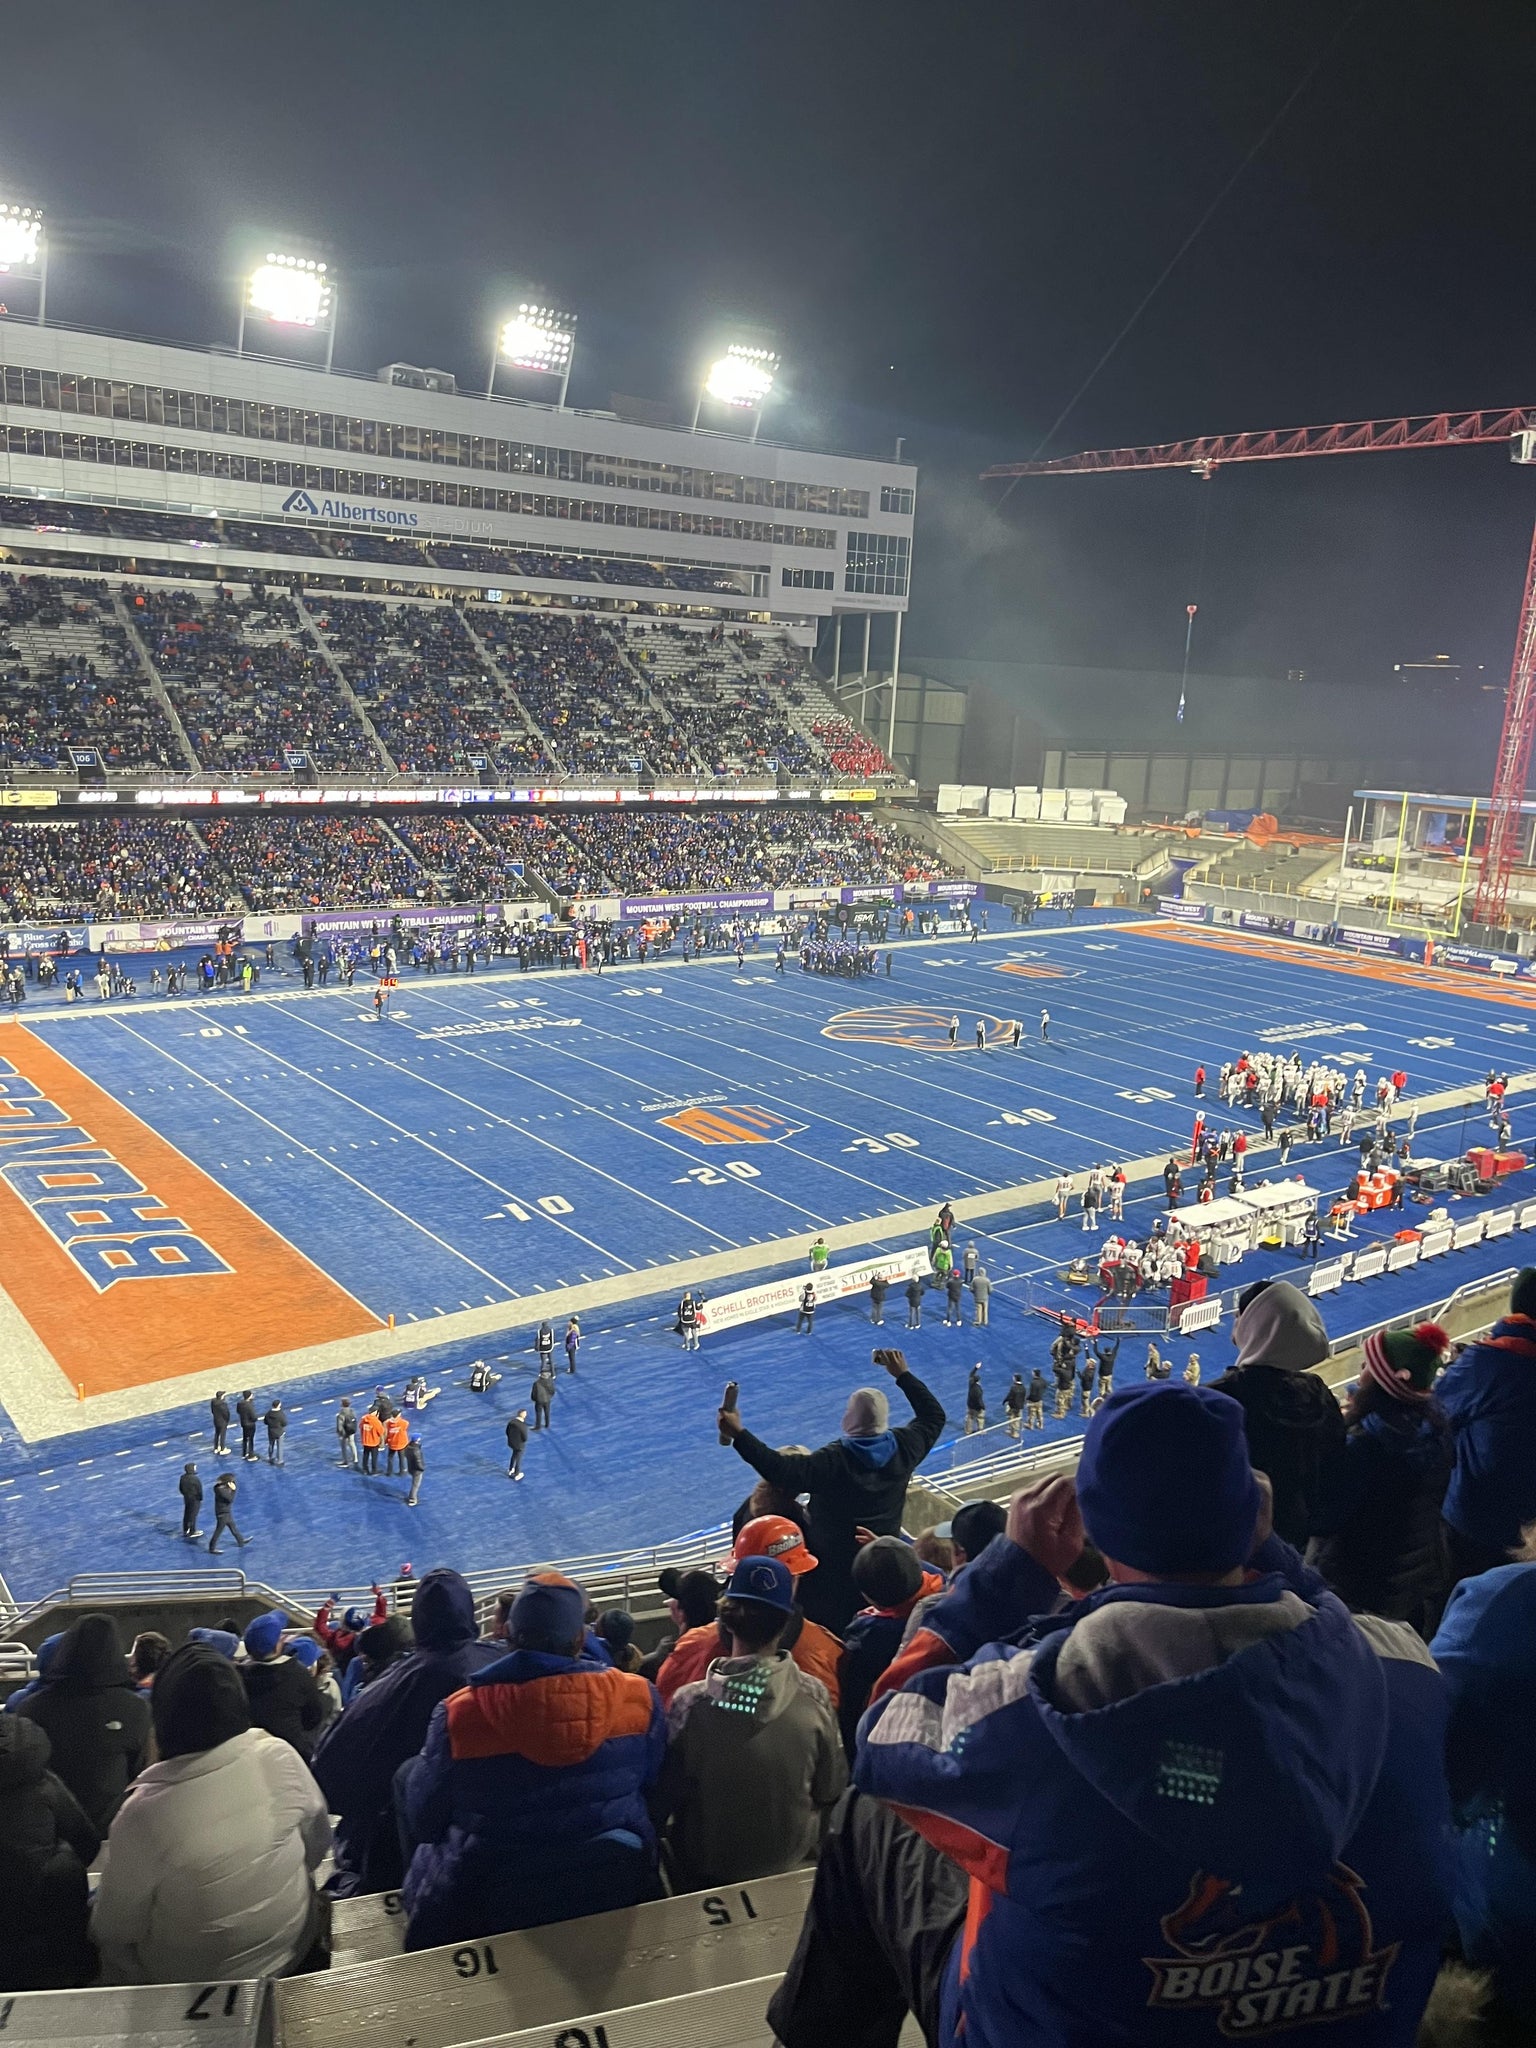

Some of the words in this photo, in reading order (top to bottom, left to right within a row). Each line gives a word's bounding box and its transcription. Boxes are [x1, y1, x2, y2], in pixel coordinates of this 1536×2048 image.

[321, 499, 418, 525] Albertsons
[76, 754, 90, 763] 106
[290, 757, 301, 765] 107
[626, 904, 664, 914] MOUNTAIN
[664, 902, 685, 911] WEST
[719, 898, 769, 908] CHAMPIONSHIP
[388, 917, 434, 928] FOTBALL
[434, 913, 498, 925] CHAMPIONHIP
[23, 933, 45, 942] Blue
[156, 926, 206, 936] MOUNTAIN
[23, 940, 49, 949] Cross
[1446, 952, 1470, 963] Agency
[496, 997, 549, 1009] 30
[199, 1025, 251, 1038] 10
[1114, 1086, 1177, 1104] 50
[1000, 1107, 1057, 1126] 40
[851, 1131, 920, 1154] 30
[687, 1160, 762, 1185] 20
[502, 1195, 575, 1222] 10
[711, 1301, 746, 1318] SCHELL
[746, 1287, 795, 1308] BROTHERS
[703, 1890, 758, 1925] 15
[453, 1945, 499, 1978] 16
[1160, 1943, 1311, 1999] BOISE
[185, 1985, 239, 2022] 17
[1231, 1964, 1378, 2028] STATE
